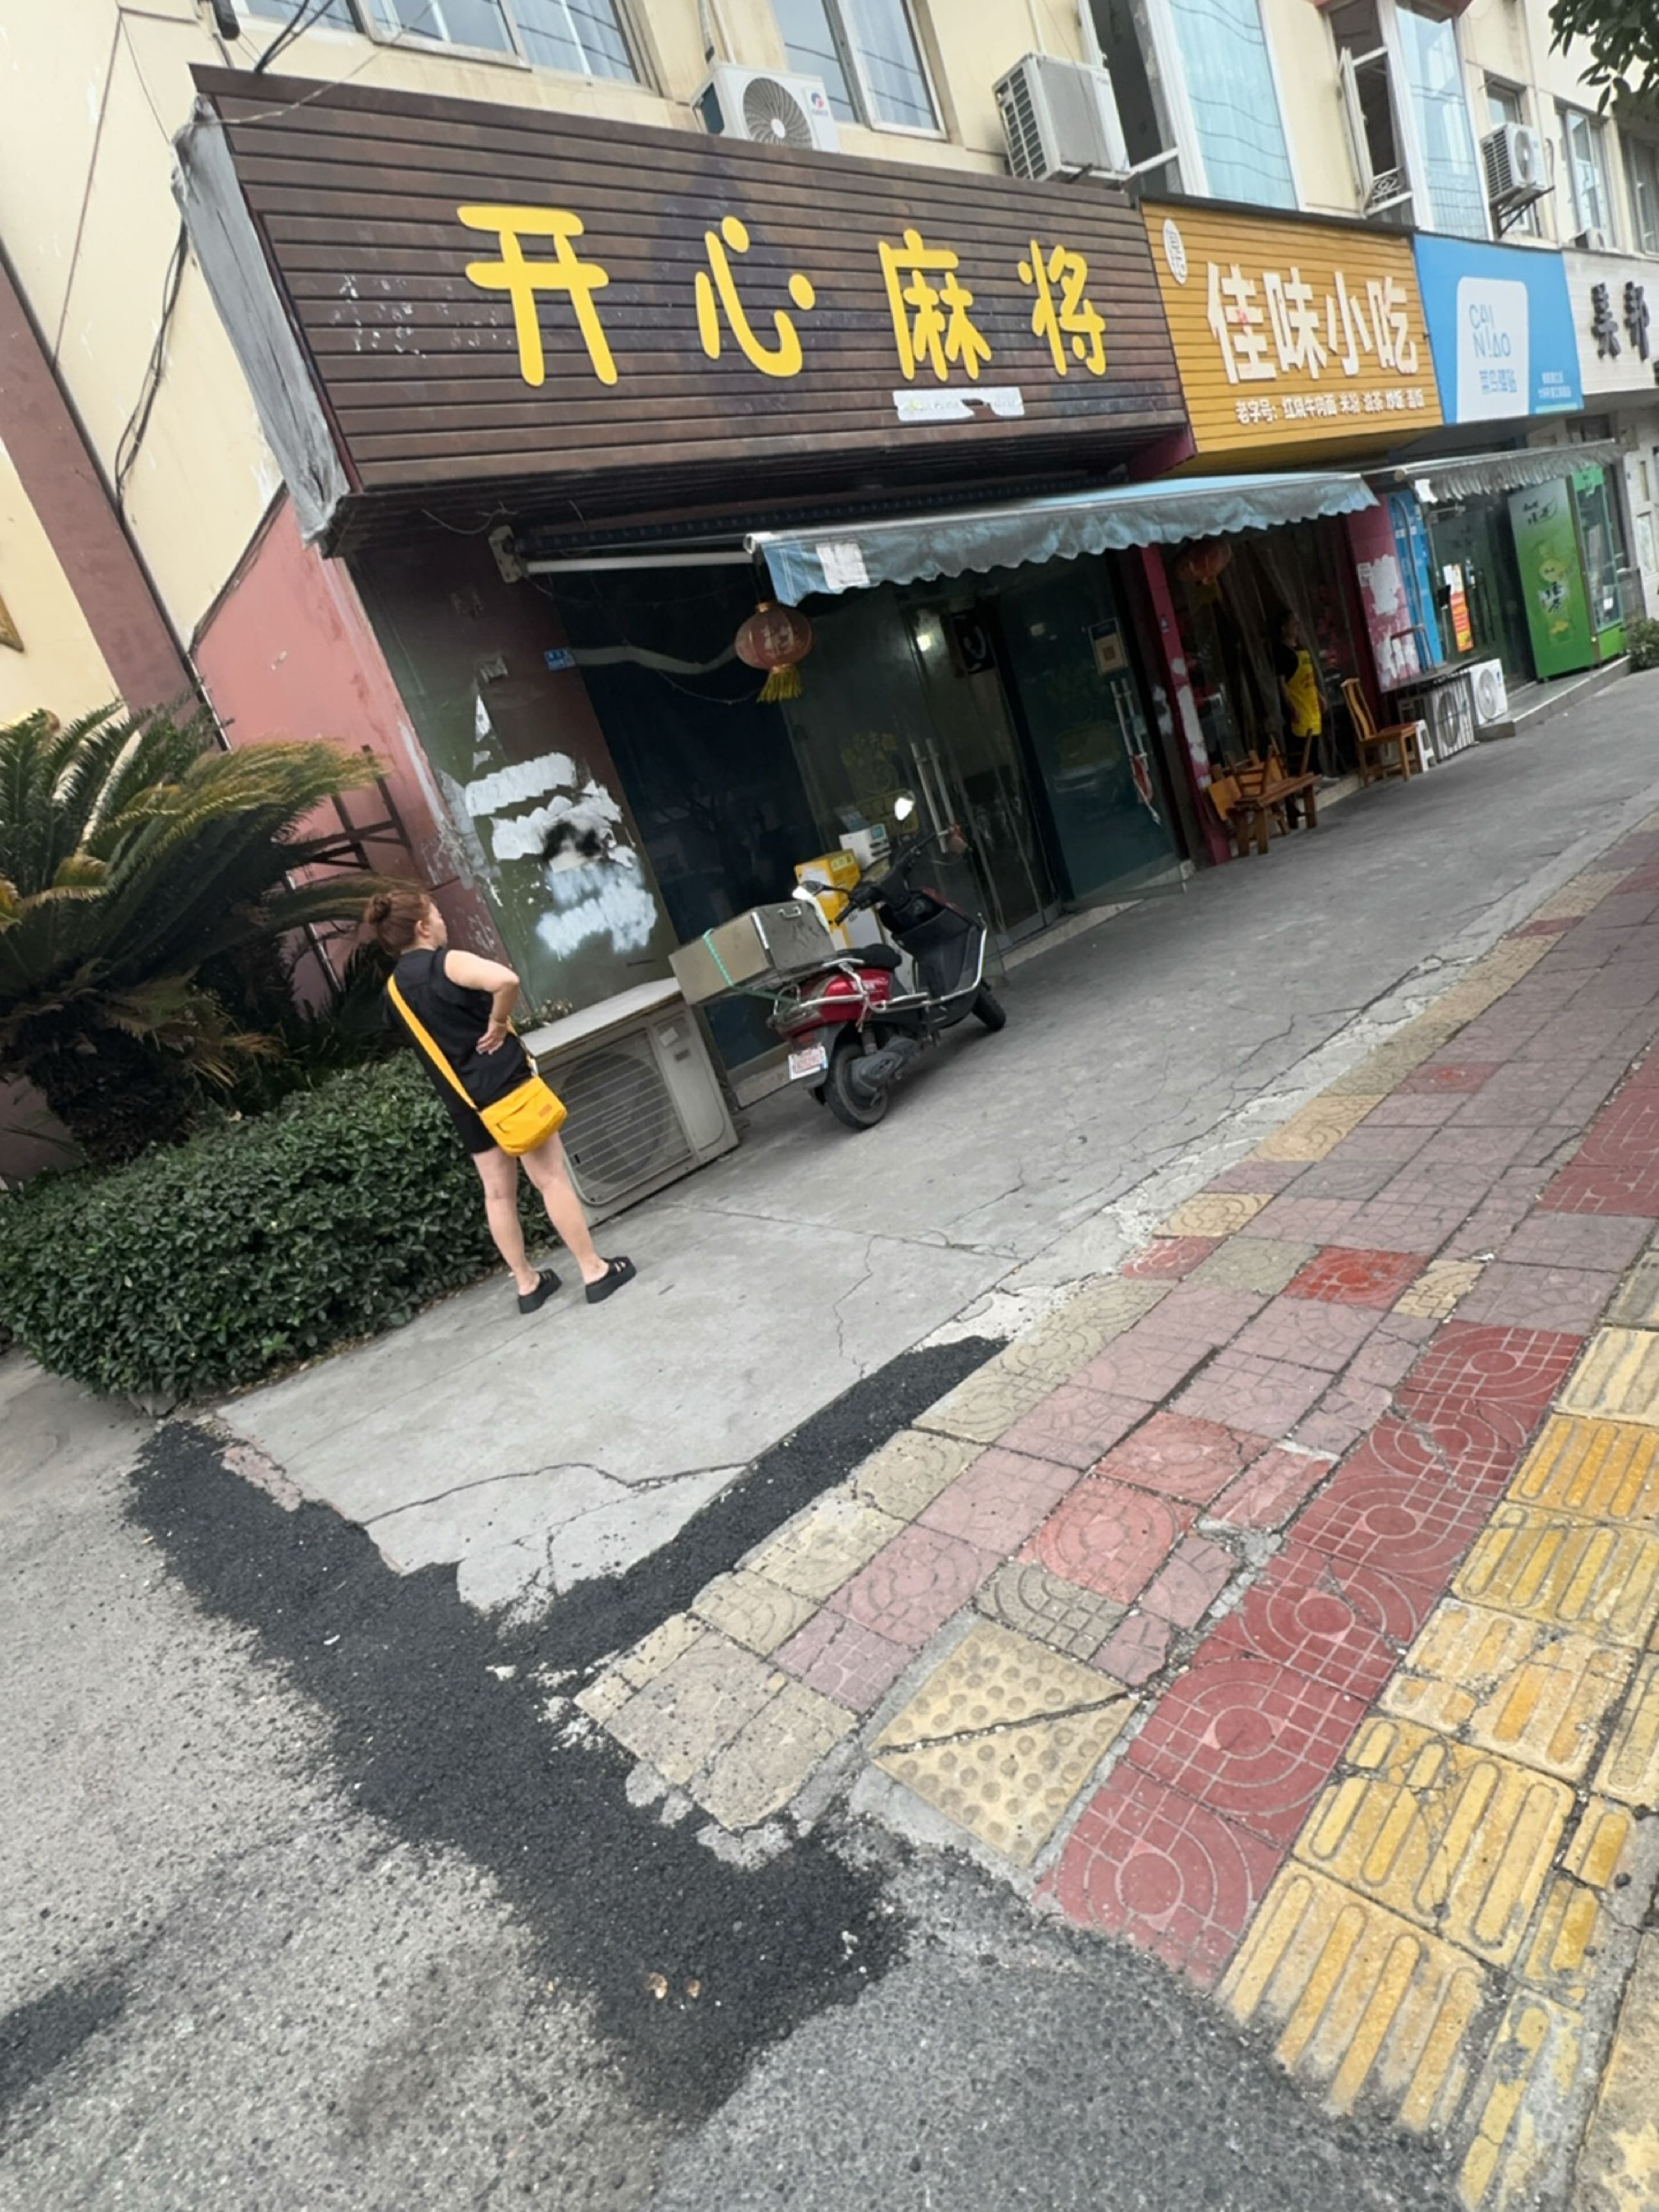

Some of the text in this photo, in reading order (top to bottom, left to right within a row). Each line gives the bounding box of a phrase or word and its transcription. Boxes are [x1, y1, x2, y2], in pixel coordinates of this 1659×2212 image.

[457, 206, 1107, 387] 开心麻将
[1207, 261, 1417, 384] 佳味小吃
